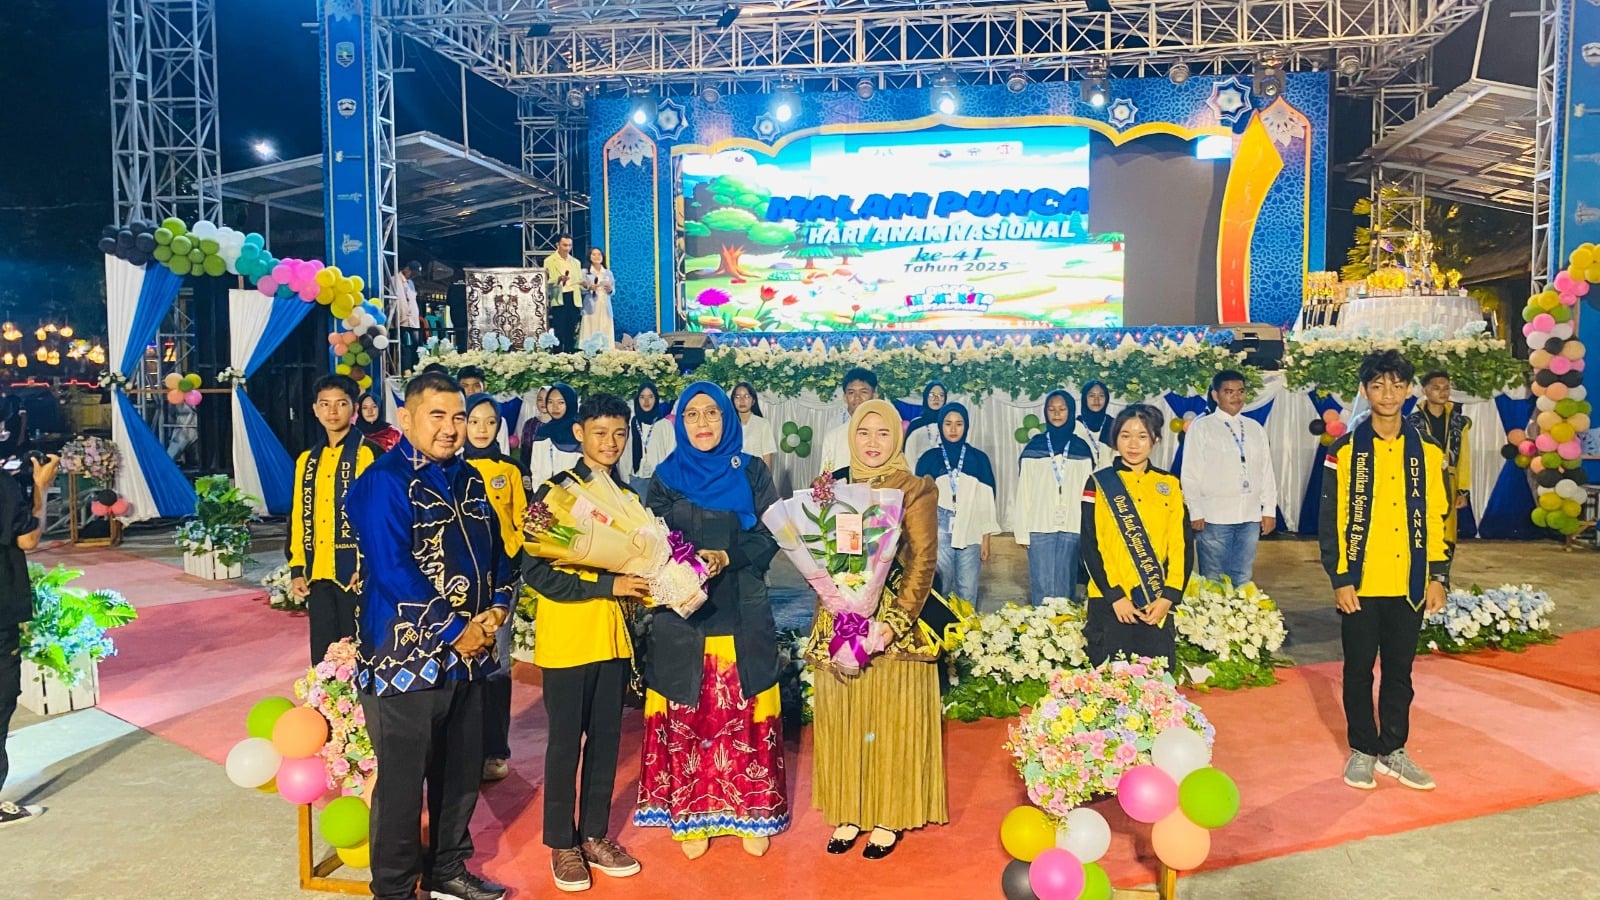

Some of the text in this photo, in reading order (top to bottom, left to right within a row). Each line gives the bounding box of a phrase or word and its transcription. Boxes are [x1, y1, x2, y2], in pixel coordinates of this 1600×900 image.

[765, 191, 933, 223] MALAM
[807, 221, 1076, 245] HARI ANAK NASIONAL
[915, 247, 984, 261] ke-41
[904, 261, 1009, 273] Tahun 2025
[303, 458, 317, 551] KAB. KOTA BARU
[1113, 494, 1129, 514] Duta
[1347, 452, 1369, 561] Pendidikan Sejarah & Budaya
[1409, 457, 1423, 549] DUTA ANAK
[1118, 513, 1142, 536] Anak
[1139, 556, 1159, 575] Kab.
